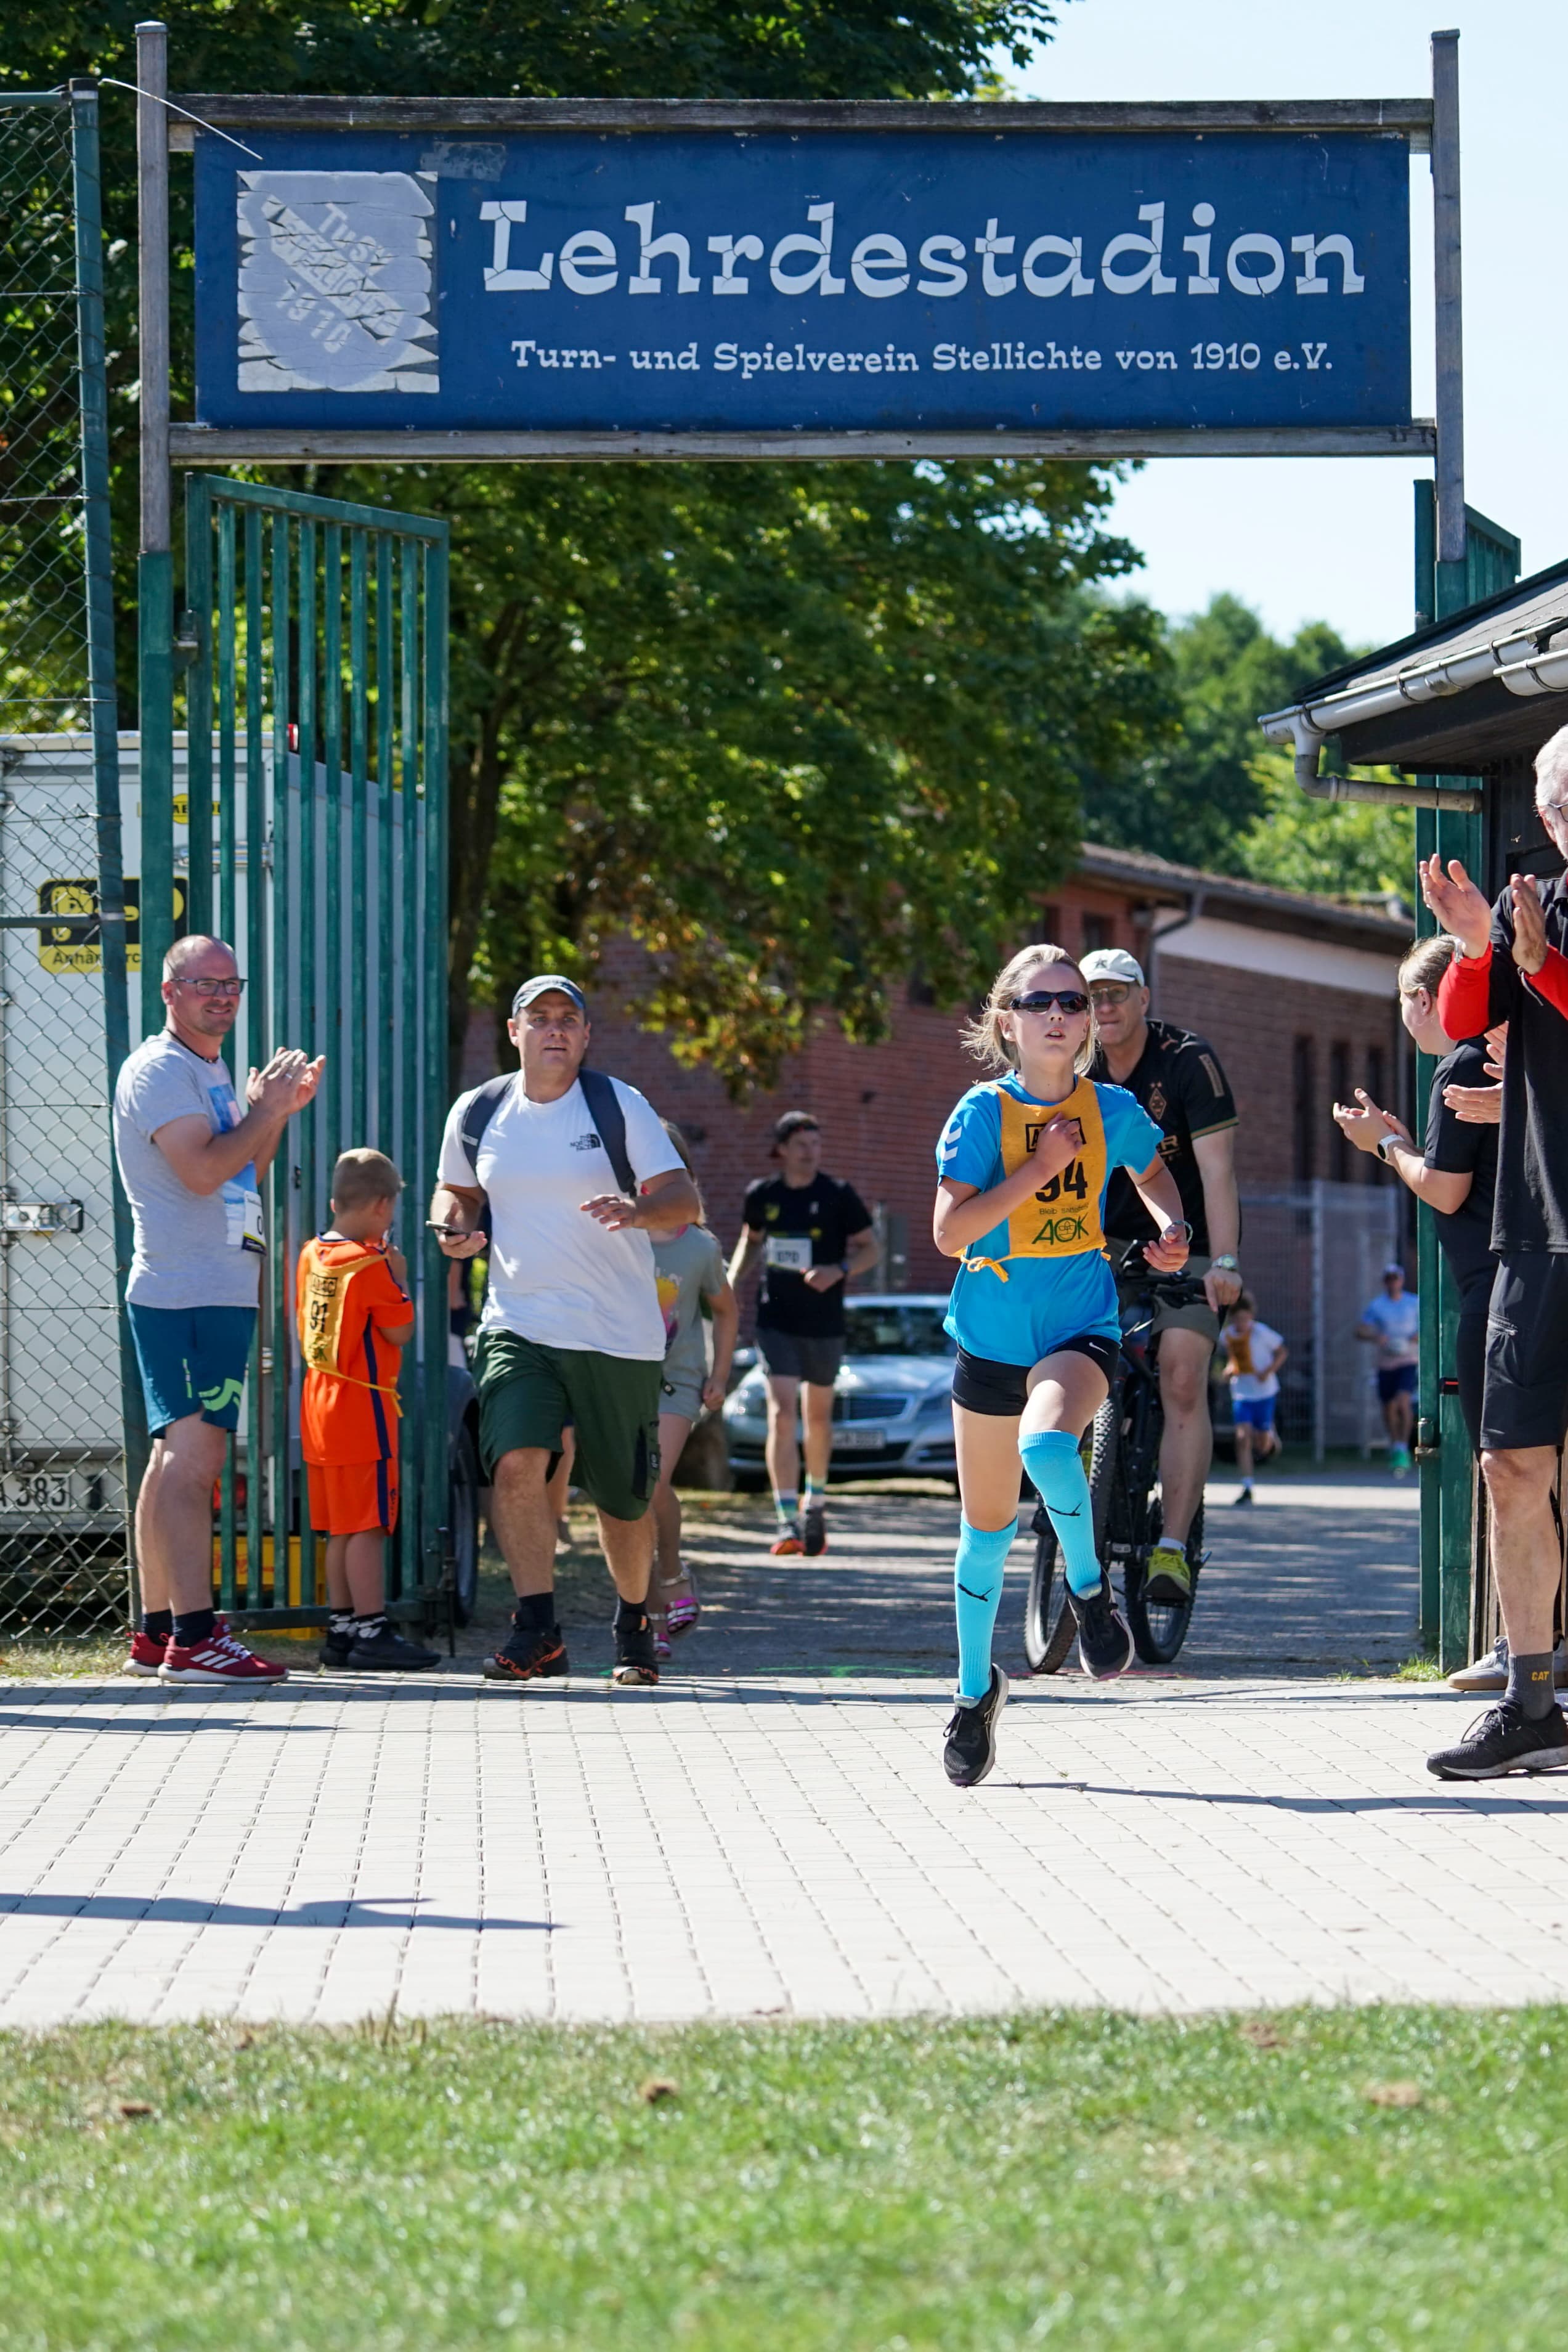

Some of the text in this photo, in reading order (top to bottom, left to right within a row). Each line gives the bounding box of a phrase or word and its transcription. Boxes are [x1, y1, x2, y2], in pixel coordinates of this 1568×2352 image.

[479, 200, 1365, 298] Lehrdestadion
[277, 279, 352, 354] 1910
[511, 340, 1333, 379] Turn- und Spielverein Stellichte von 1910 e.V.
[1031, 1212, 1089, 1245] AOK
[310, 1300, 327, 1333] 91
[16, 1477, 65, 1506] 383
[1531, 1670, 1550, 1681] CAT
